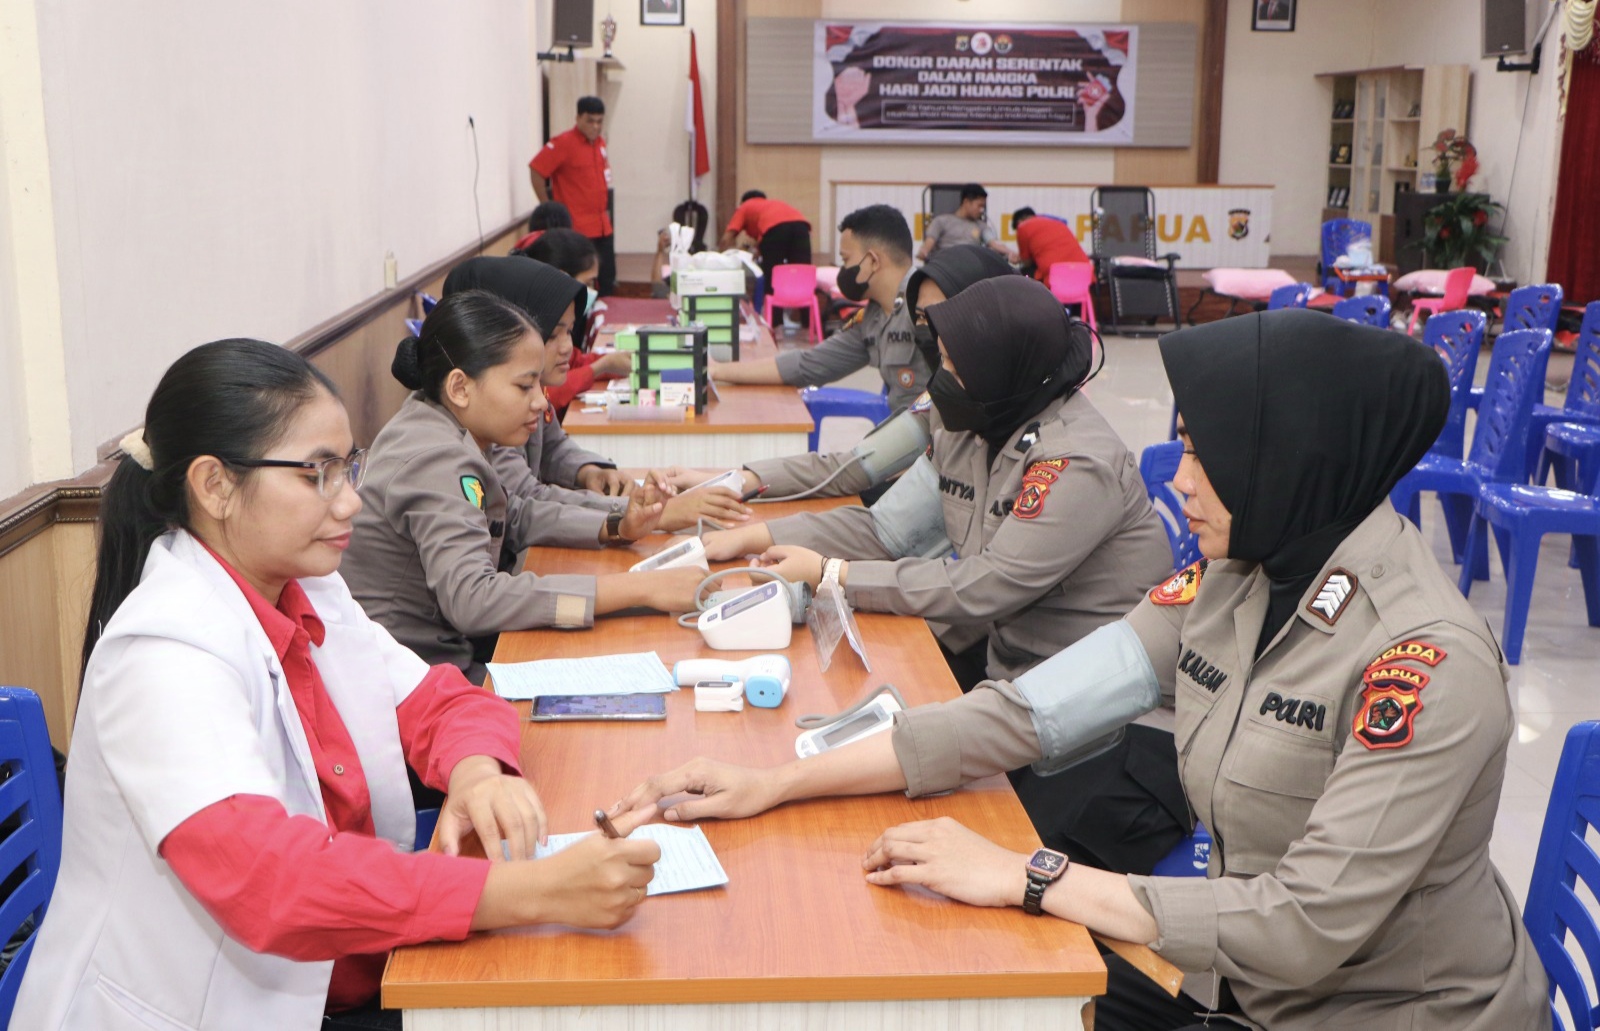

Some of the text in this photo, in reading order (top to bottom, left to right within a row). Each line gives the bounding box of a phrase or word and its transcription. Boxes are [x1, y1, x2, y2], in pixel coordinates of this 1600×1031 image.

[872, 55, 1082, 71] DONOR DARAH SERENTAK
[918, 71, 1037, 84] DALAM RANGKA
[879, 83, 1074, 99] HARI JADI HUMAS POLRI
[1076, 214, 1211, 242] PAPUA
[1371, 668, 1421, 684] PAPUA
[1259, 691, 1326, 731] POLRI
